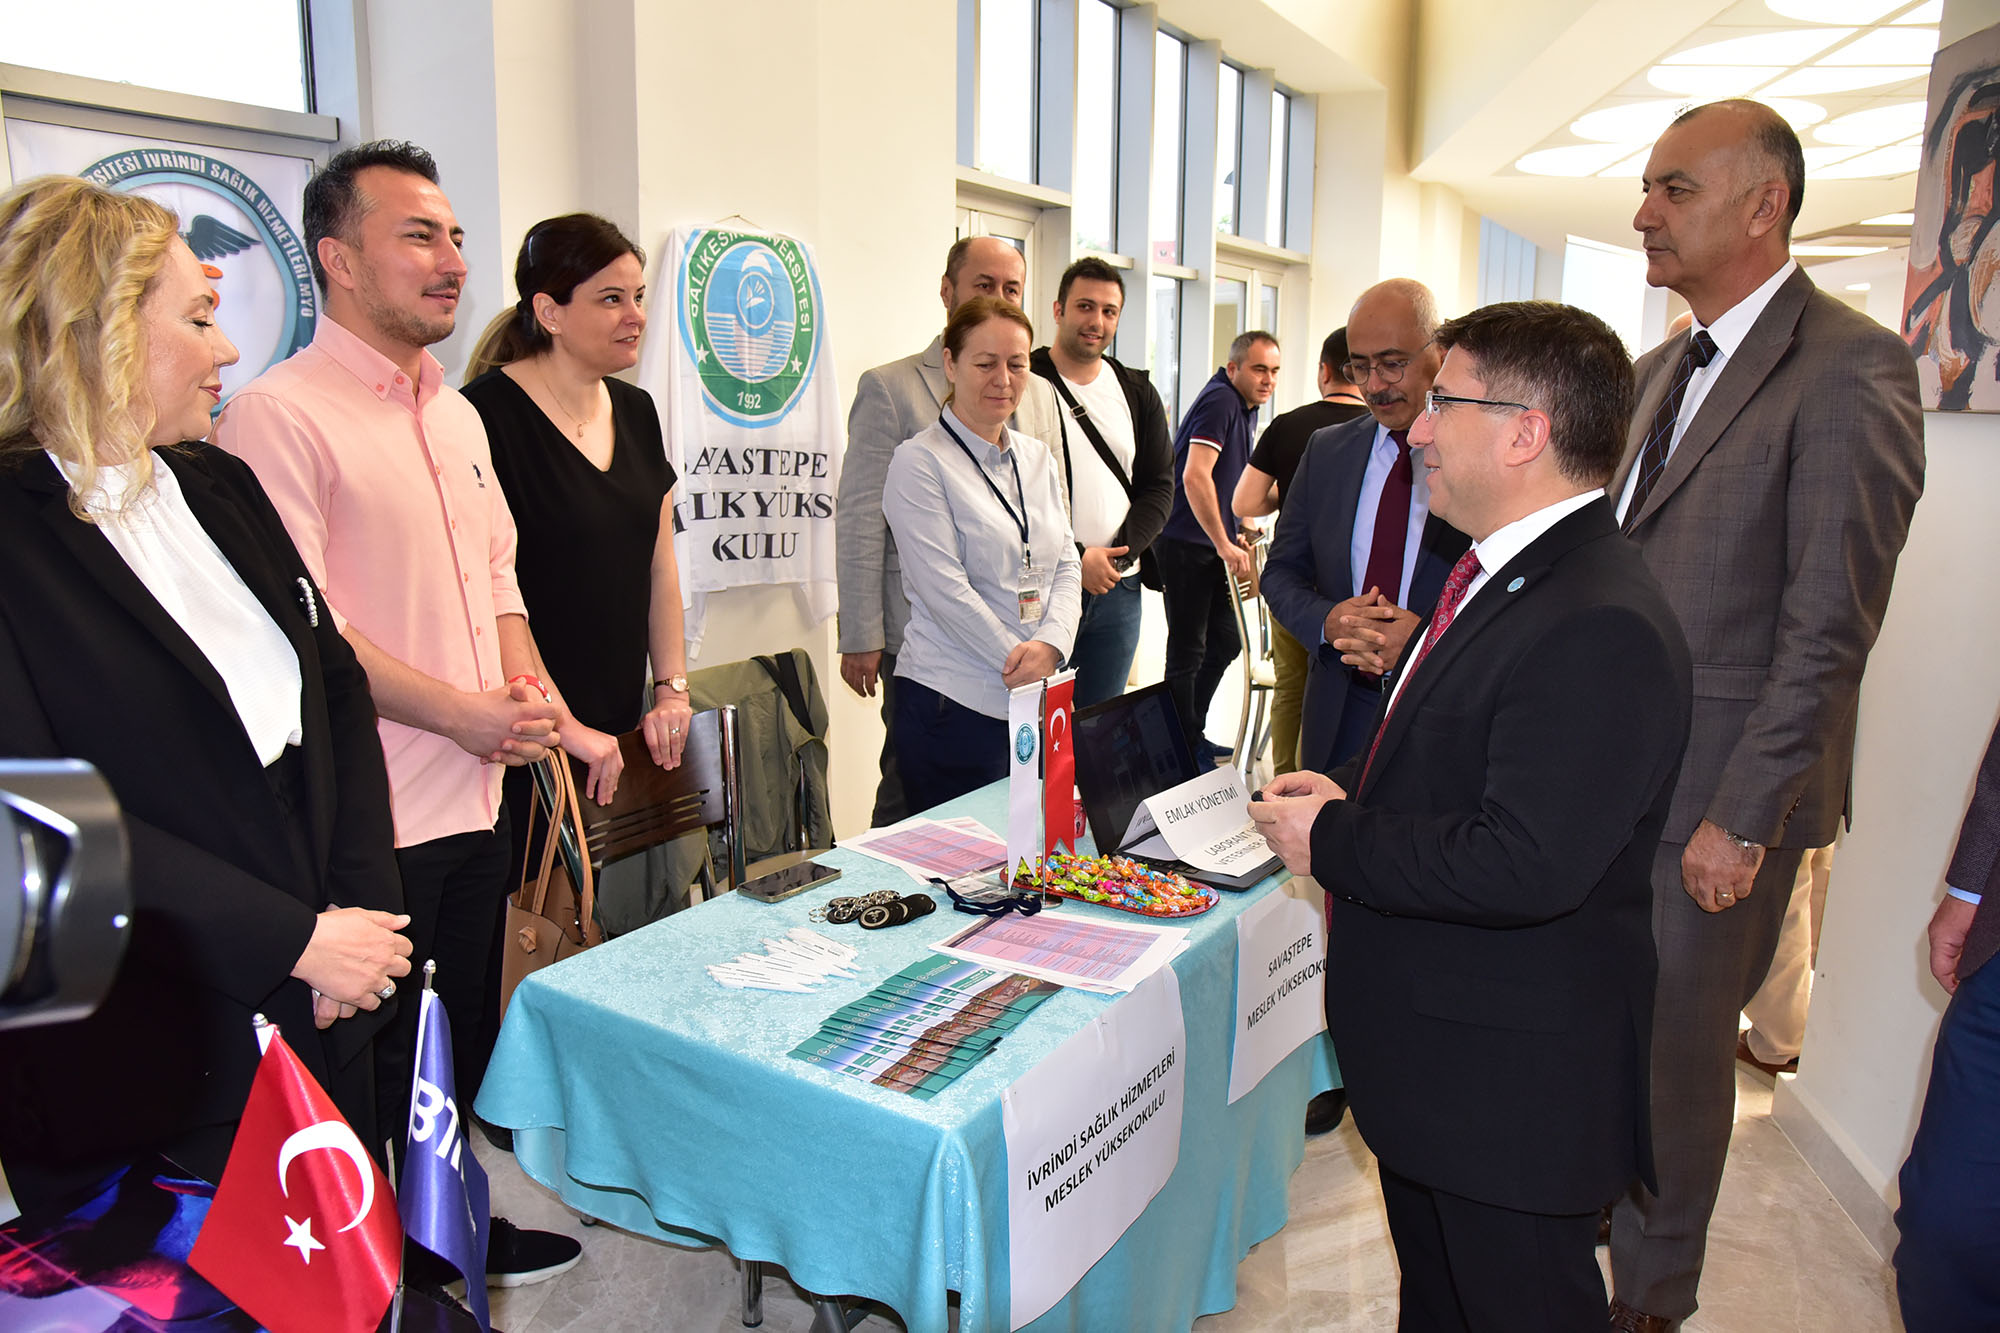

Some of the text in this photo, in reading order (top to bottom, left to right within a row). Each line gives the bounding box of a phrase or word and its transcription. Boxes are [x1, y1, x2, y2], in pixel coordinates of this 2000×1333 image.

[141, 150, 206, 172] İVRİNDİ
[210, 162, 258, 203] SAĞLIK
[256, 198, 309, 280] HİZMETLERİ
[299, 283, 314, 318] MYO
[736, 391, 761, 409] 1992
[1164, 802, 1199, 825] EMLAK
[1196, 783, 1239, 815] YÖNETİMİ
[1204, 831, 1252, 856] LABORANT
[1268, 933, 1313, 978] SAVAŞTEPE
[1247, 992, 1276, 1031] MESLEK
[1027, 1046, 1175, 1191] İVRİNDİ SAĞLIK HİZMETLERİ
[1045, 1089, 1166, 1213] MESLEK YÜKSEKOKULU
